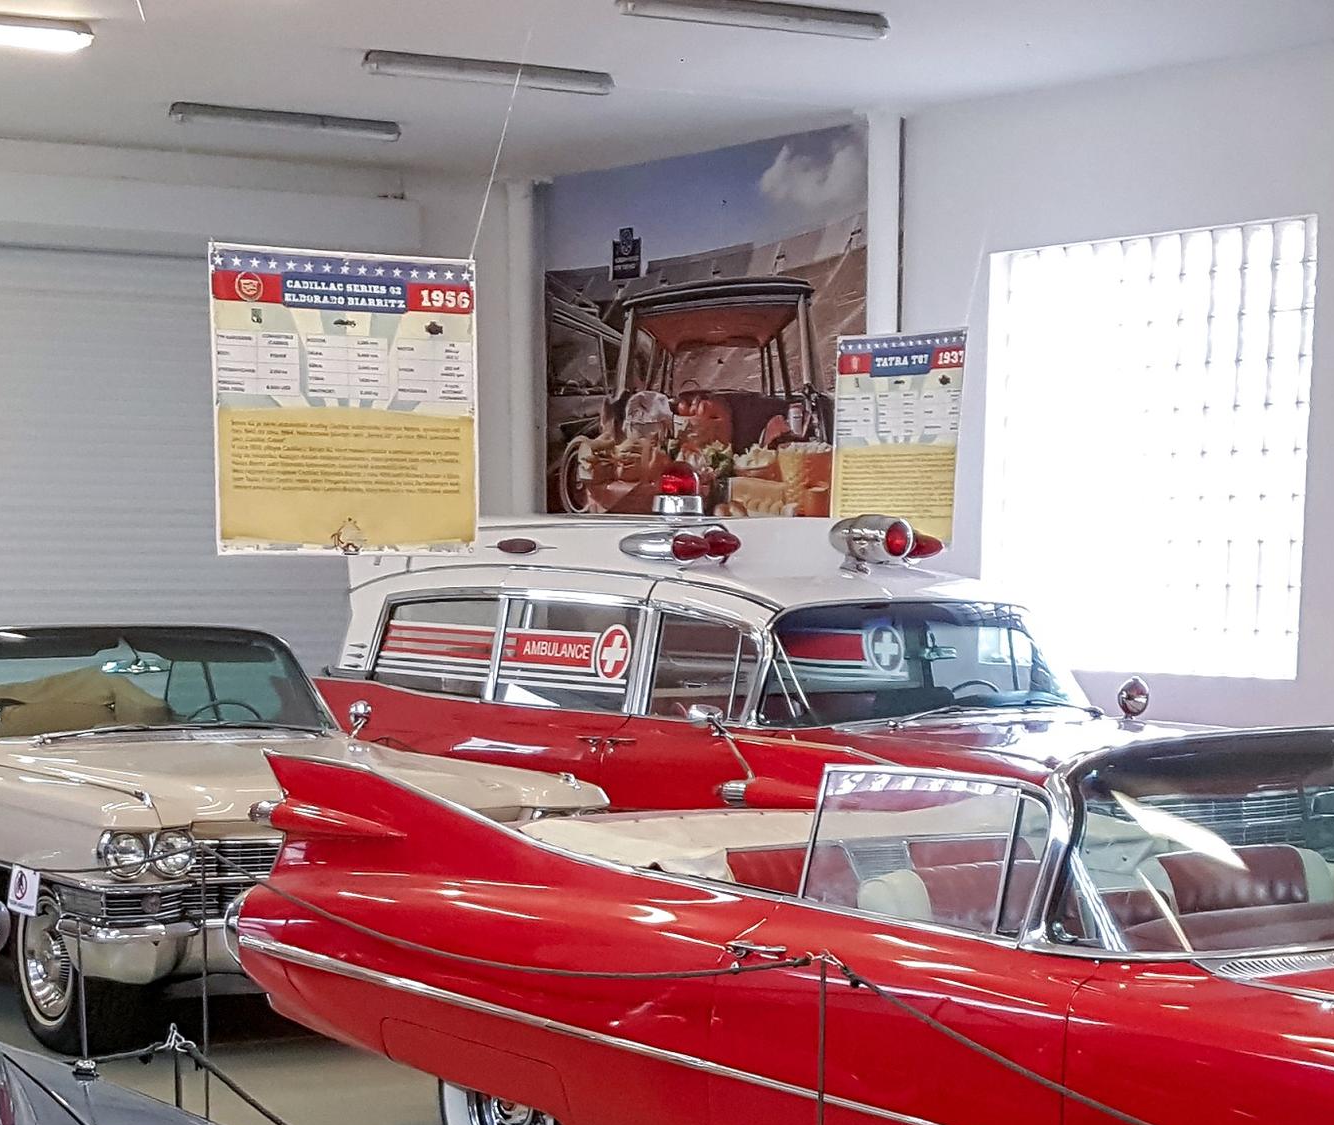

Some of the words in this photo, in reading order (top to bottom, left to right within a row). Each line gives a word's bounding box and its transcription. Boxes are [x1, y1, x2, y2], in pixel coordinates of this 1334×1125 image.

[286, 279, 344, 292] CADILLAC
[346, 283, 387, 294] SERIES
[284, 292, 346, 305] ELDORADO
[347, 297, 406, 309] BIARRITZ
[420, 288, 471, 309] 1956
[875, 355, 909, 368] TATRA
[937, 350, 964, 365] 1937
[522, 641, 589, 660] AMBULANCE
